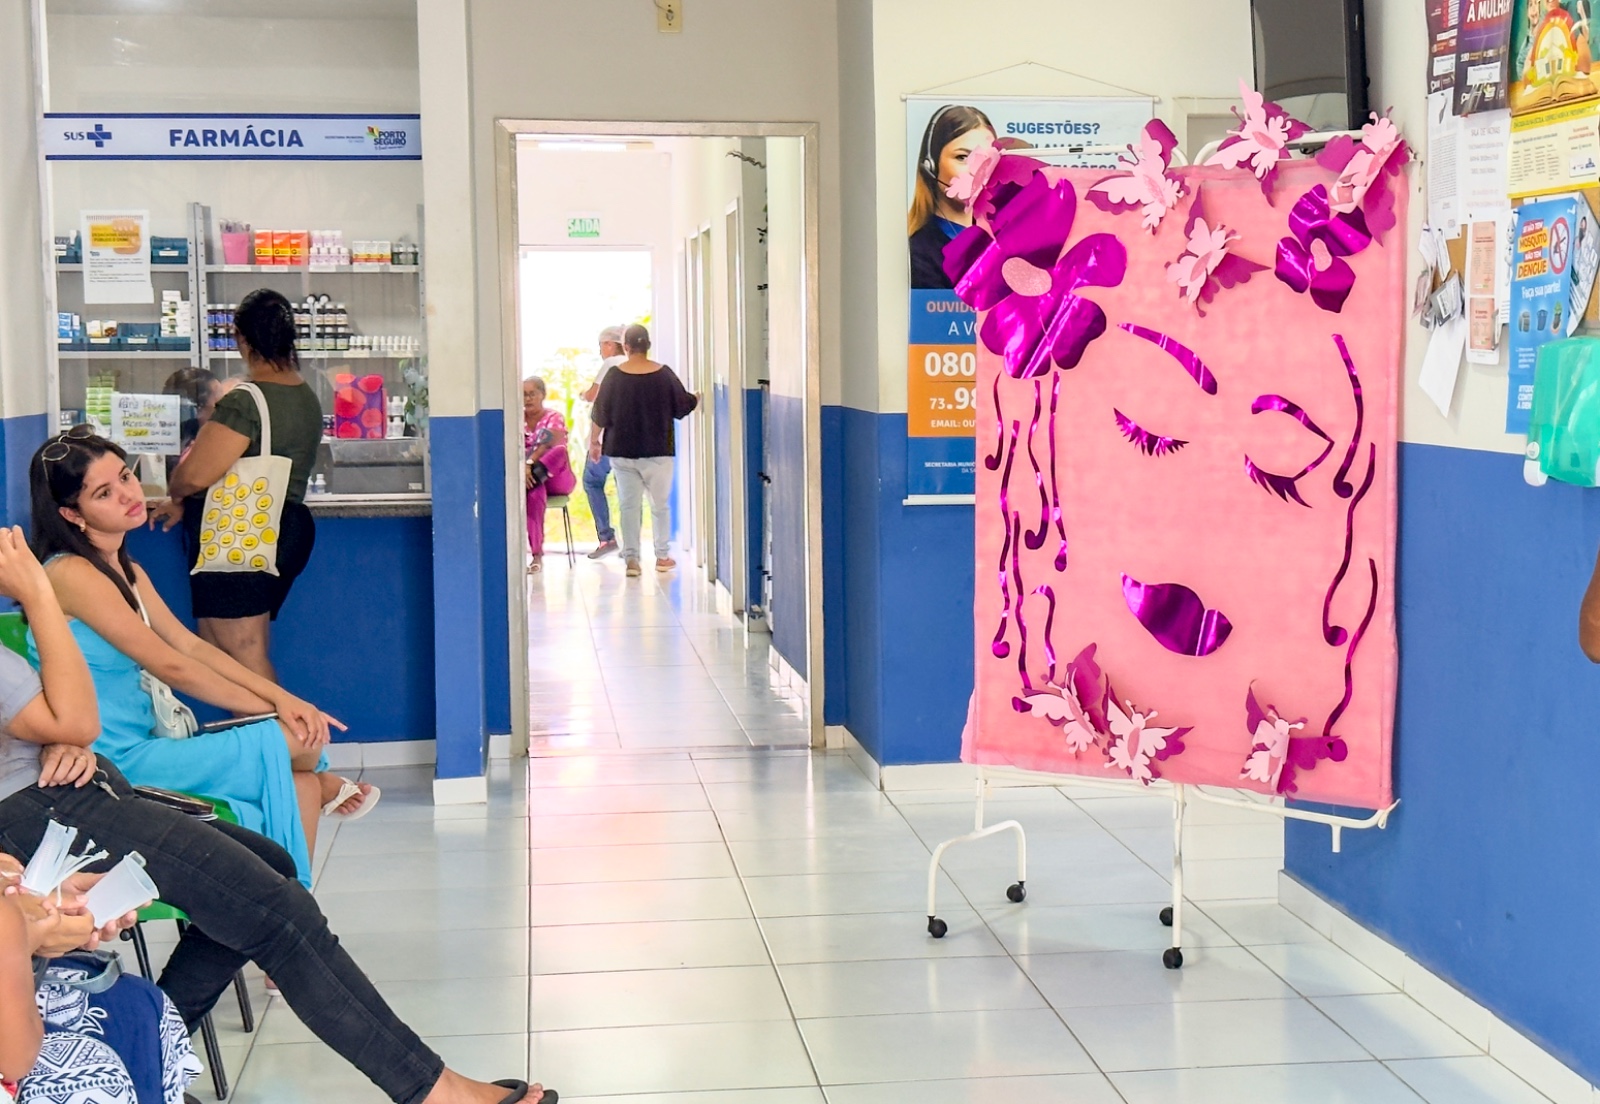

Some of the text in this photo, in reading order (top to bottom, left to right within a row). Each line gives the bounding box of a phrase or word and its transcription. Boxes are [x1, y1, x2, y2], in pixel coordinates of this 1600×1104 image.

[1466, 0, 1476, 23] À
[1477, 0, 1511, 21] MULHER
[378, 131, 407, 139] PORTO
[1006, 120, 1101, 135] SUGESTÕES?
[64, 131, 85, 141] SUS
[169, 125, 304, 148] FARMÁCIA
[374, 138, 407, 146] SEGURO
[1519, 232, 1548, 249] MOSQUITO
[1517, 260, 1547, 278] DENGUE
[1521, 287, 1534, 301] Faça
[1535, 286, 1544, 297] sua
[948, 321, 960, 336] A
[924, 352, 976, 377] 080
[931, 419, 961, 428] EMAIL:
